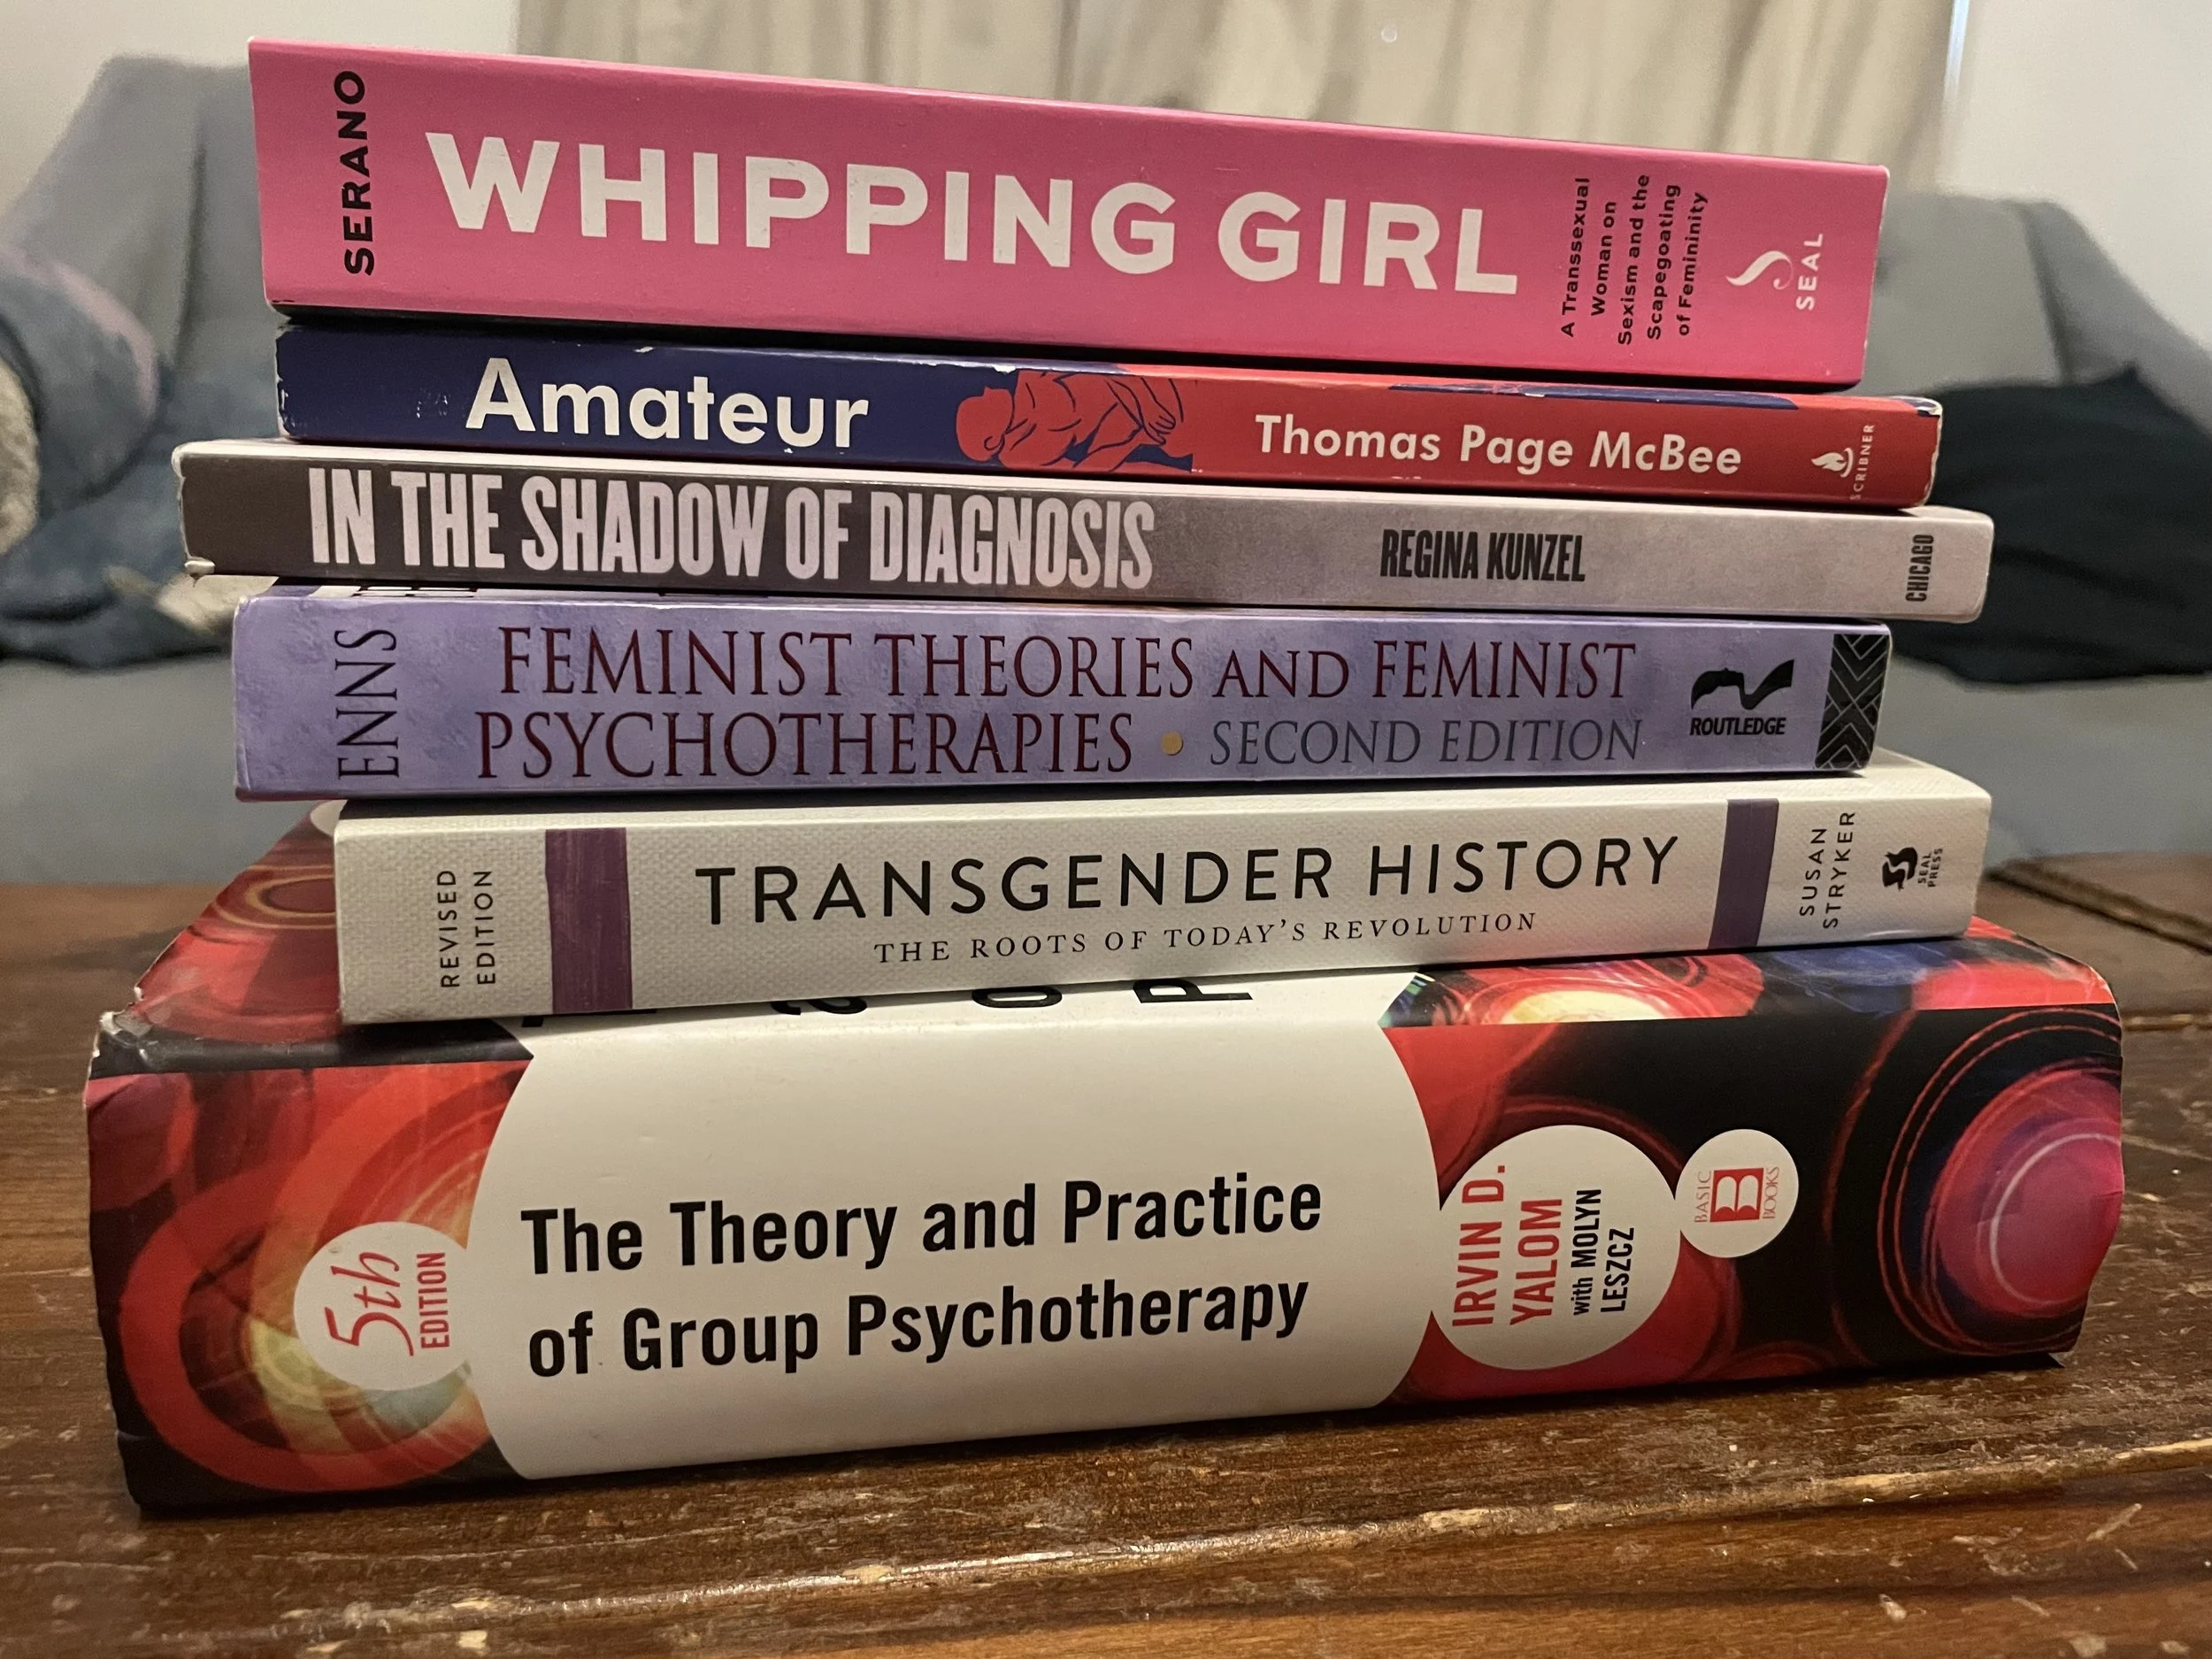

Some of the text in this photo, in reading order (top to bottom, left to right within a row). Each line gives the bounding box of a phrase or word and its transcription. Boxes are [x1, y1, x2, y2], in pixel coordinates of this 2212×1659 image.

[334, 70, 374, 276] SERANO
[426, 132, 1517, 295] WHIPPING GIRL
[1561, 178, 1590, 338] A Transsexual
[1591, 201, 1617, 317] Woman on
[1618, 174, 1650, 345] Sexism and the
[1647, 184, 1681, 341] Scapegoating
[1678, 192, 1709, 336] of Femininity
[1796, 234, 1824, 311] SEAL
[465, 357, 869, 448] Amateur
[1256, 415, 1741, 475] Thomas Page McBee
[309, 467, 1155, 590] IN THE SHADOW OF DIAGNOSIS
[1380, 528, 1586, 582] REGINA KUNZEL
[1905, 534, 1934, 602] CHICAGO
[334, 628, 399, 780] ENNS
[499, 626, 1636, 699] FEMINIST THEORIES AND FEMINIST
[476, 711, 1643, 779] PSYCHOTHERAPIES SECOND EDITION
[1690, 716, 1786, 737] ROUTLEDGE
[695, 836, 1678, 925] TRANSGENDER HISTORY
[1800, 829, 1827, 916] SUSAN
[1823, 812, 1855, 928] STRYKER
[1917, 852, 1931, 884] SEAL
[1927, 849, 1943, 887] PRESS
[437, 870, 460, 987] REVISED
[475, 871, 496, 986] EDITION
[875, 941, 949, 964] THE
[971, 933, 1087, 958] ROOTS
[1104, 929, 1147, 951] OF
[1325, 913, 1536, 941] REVOLUTION
[521, 1172, 1321, 1274] The Theory and Practice
[1694, 1171, 1711, 1223] BASIC
[1763, 1166, 1779, 1218] BOOKS
[1452, 1164, 1505, 1327] IRVIN D.
[1509, 1199, 1563, 1325] YALOM
[1571, 1189, 1601, 1316] with MOLYN
[1601, 1227, 1634, 1313] LESZCZ
[325, 1251, 414, 1356] 5th
[417, 1252, 450, 1349] EDITION
[529, 1279, 1309, 1377] of Group Psychotherapy
